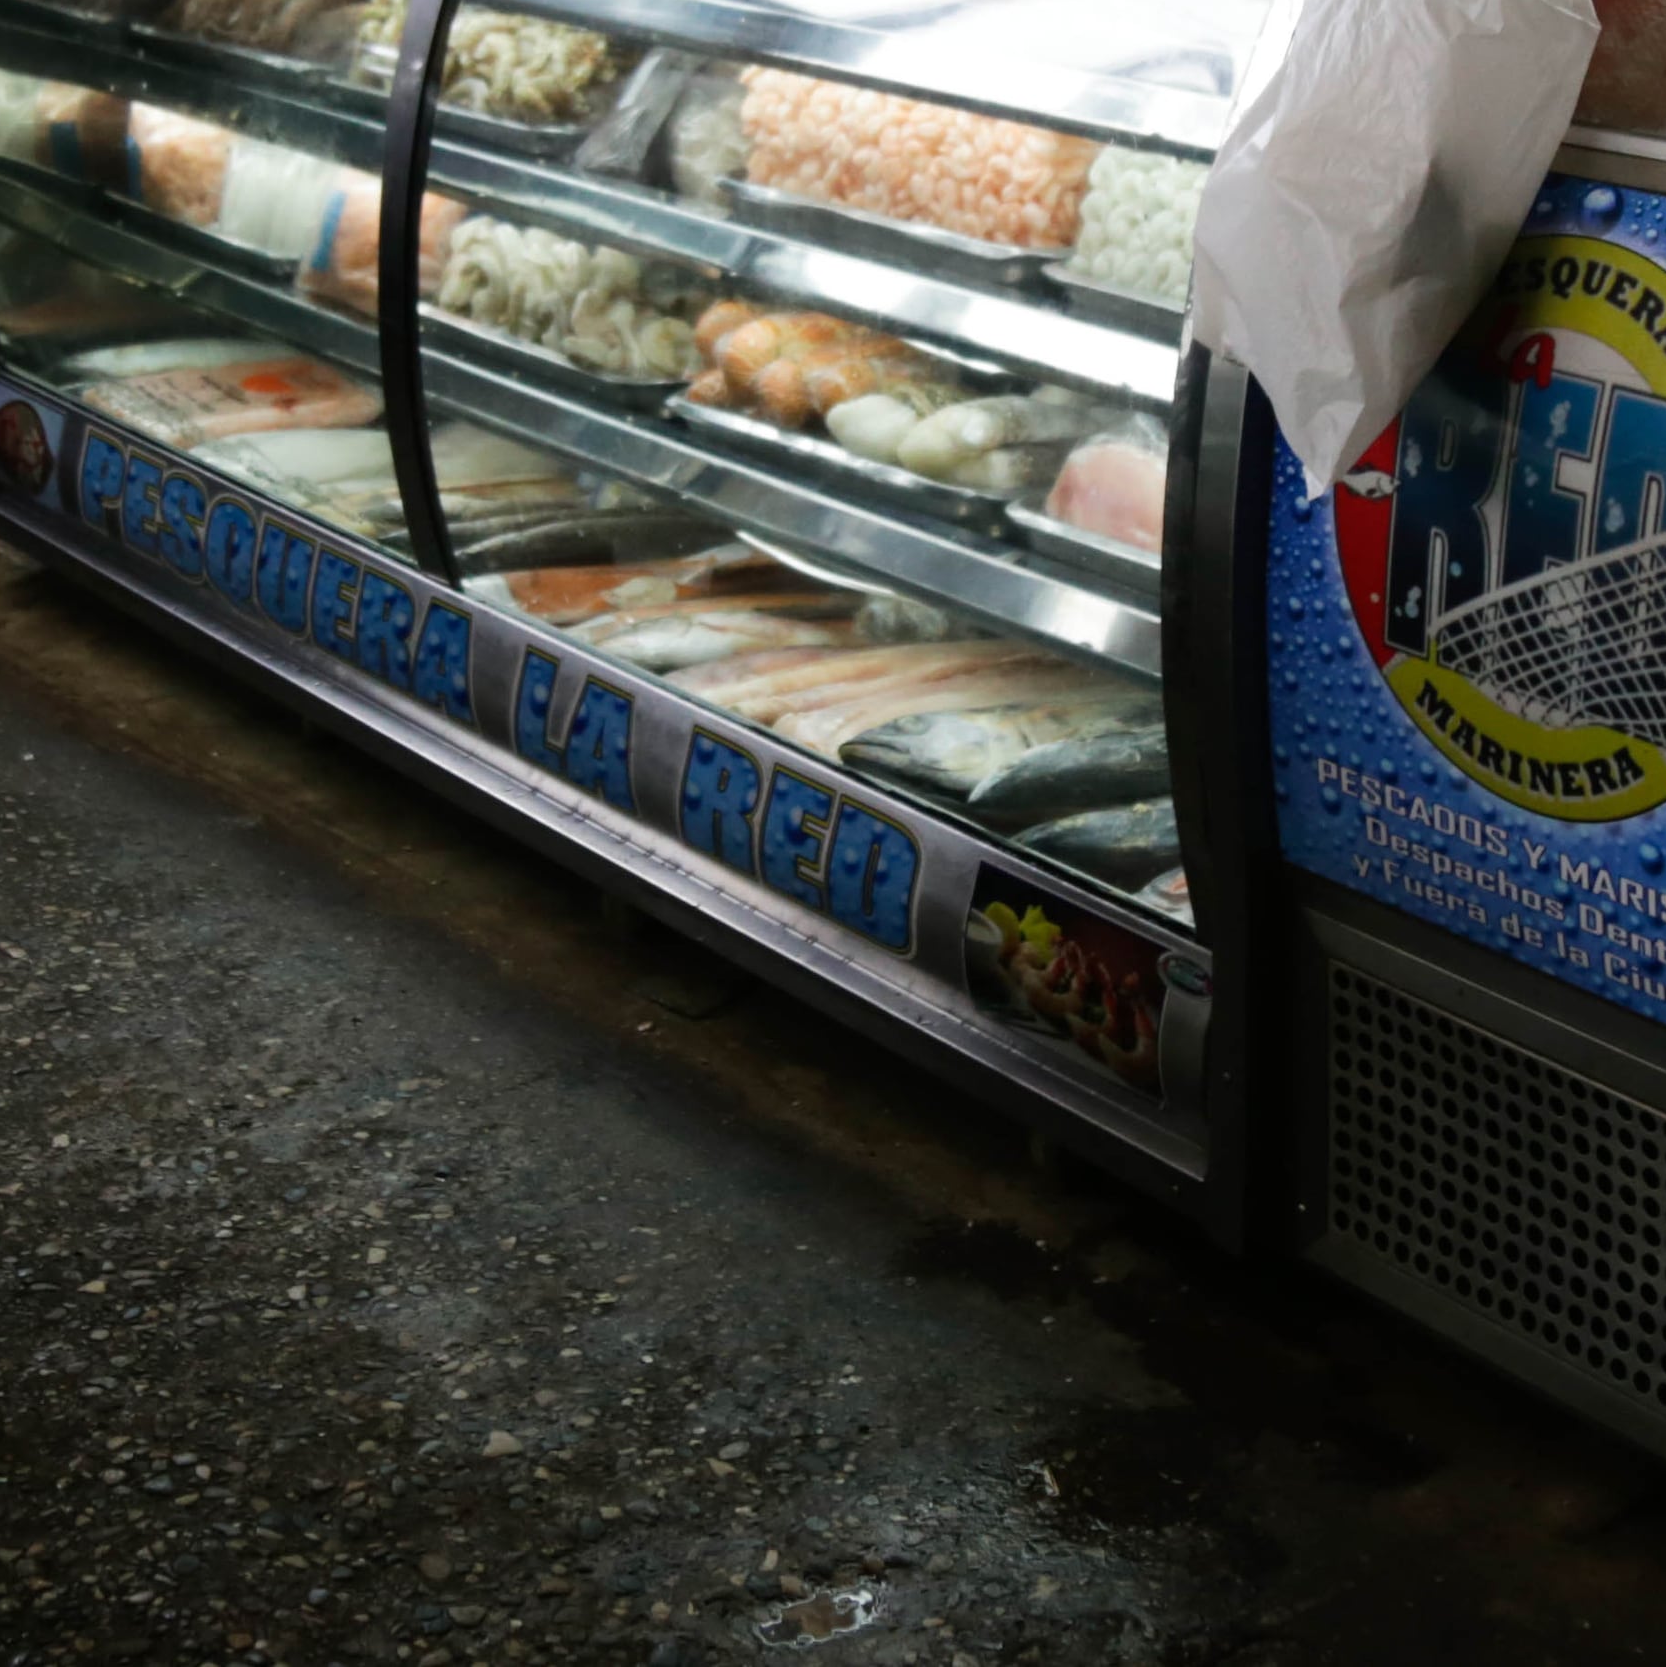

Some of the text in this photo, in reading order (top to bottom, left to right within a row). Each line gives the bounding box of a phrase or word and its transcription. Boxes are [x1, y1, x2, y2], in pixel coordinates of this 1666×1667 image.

[77, 424, 924, 960] PESQUERA LA RED
[1413, 678, 1646, 799] MARINERA
[1317, 758, 1510, 858] PESCADOS
[1522, 839, 1546, 870] Y
[1364, 817, 1565, 923] Despachos
[1353, 854, 1370, 879] y
[1383, 862, 1487, 925] Fuera
[1500, 912, 1544, 950] de
[1556, 935, 1591, 969] la
